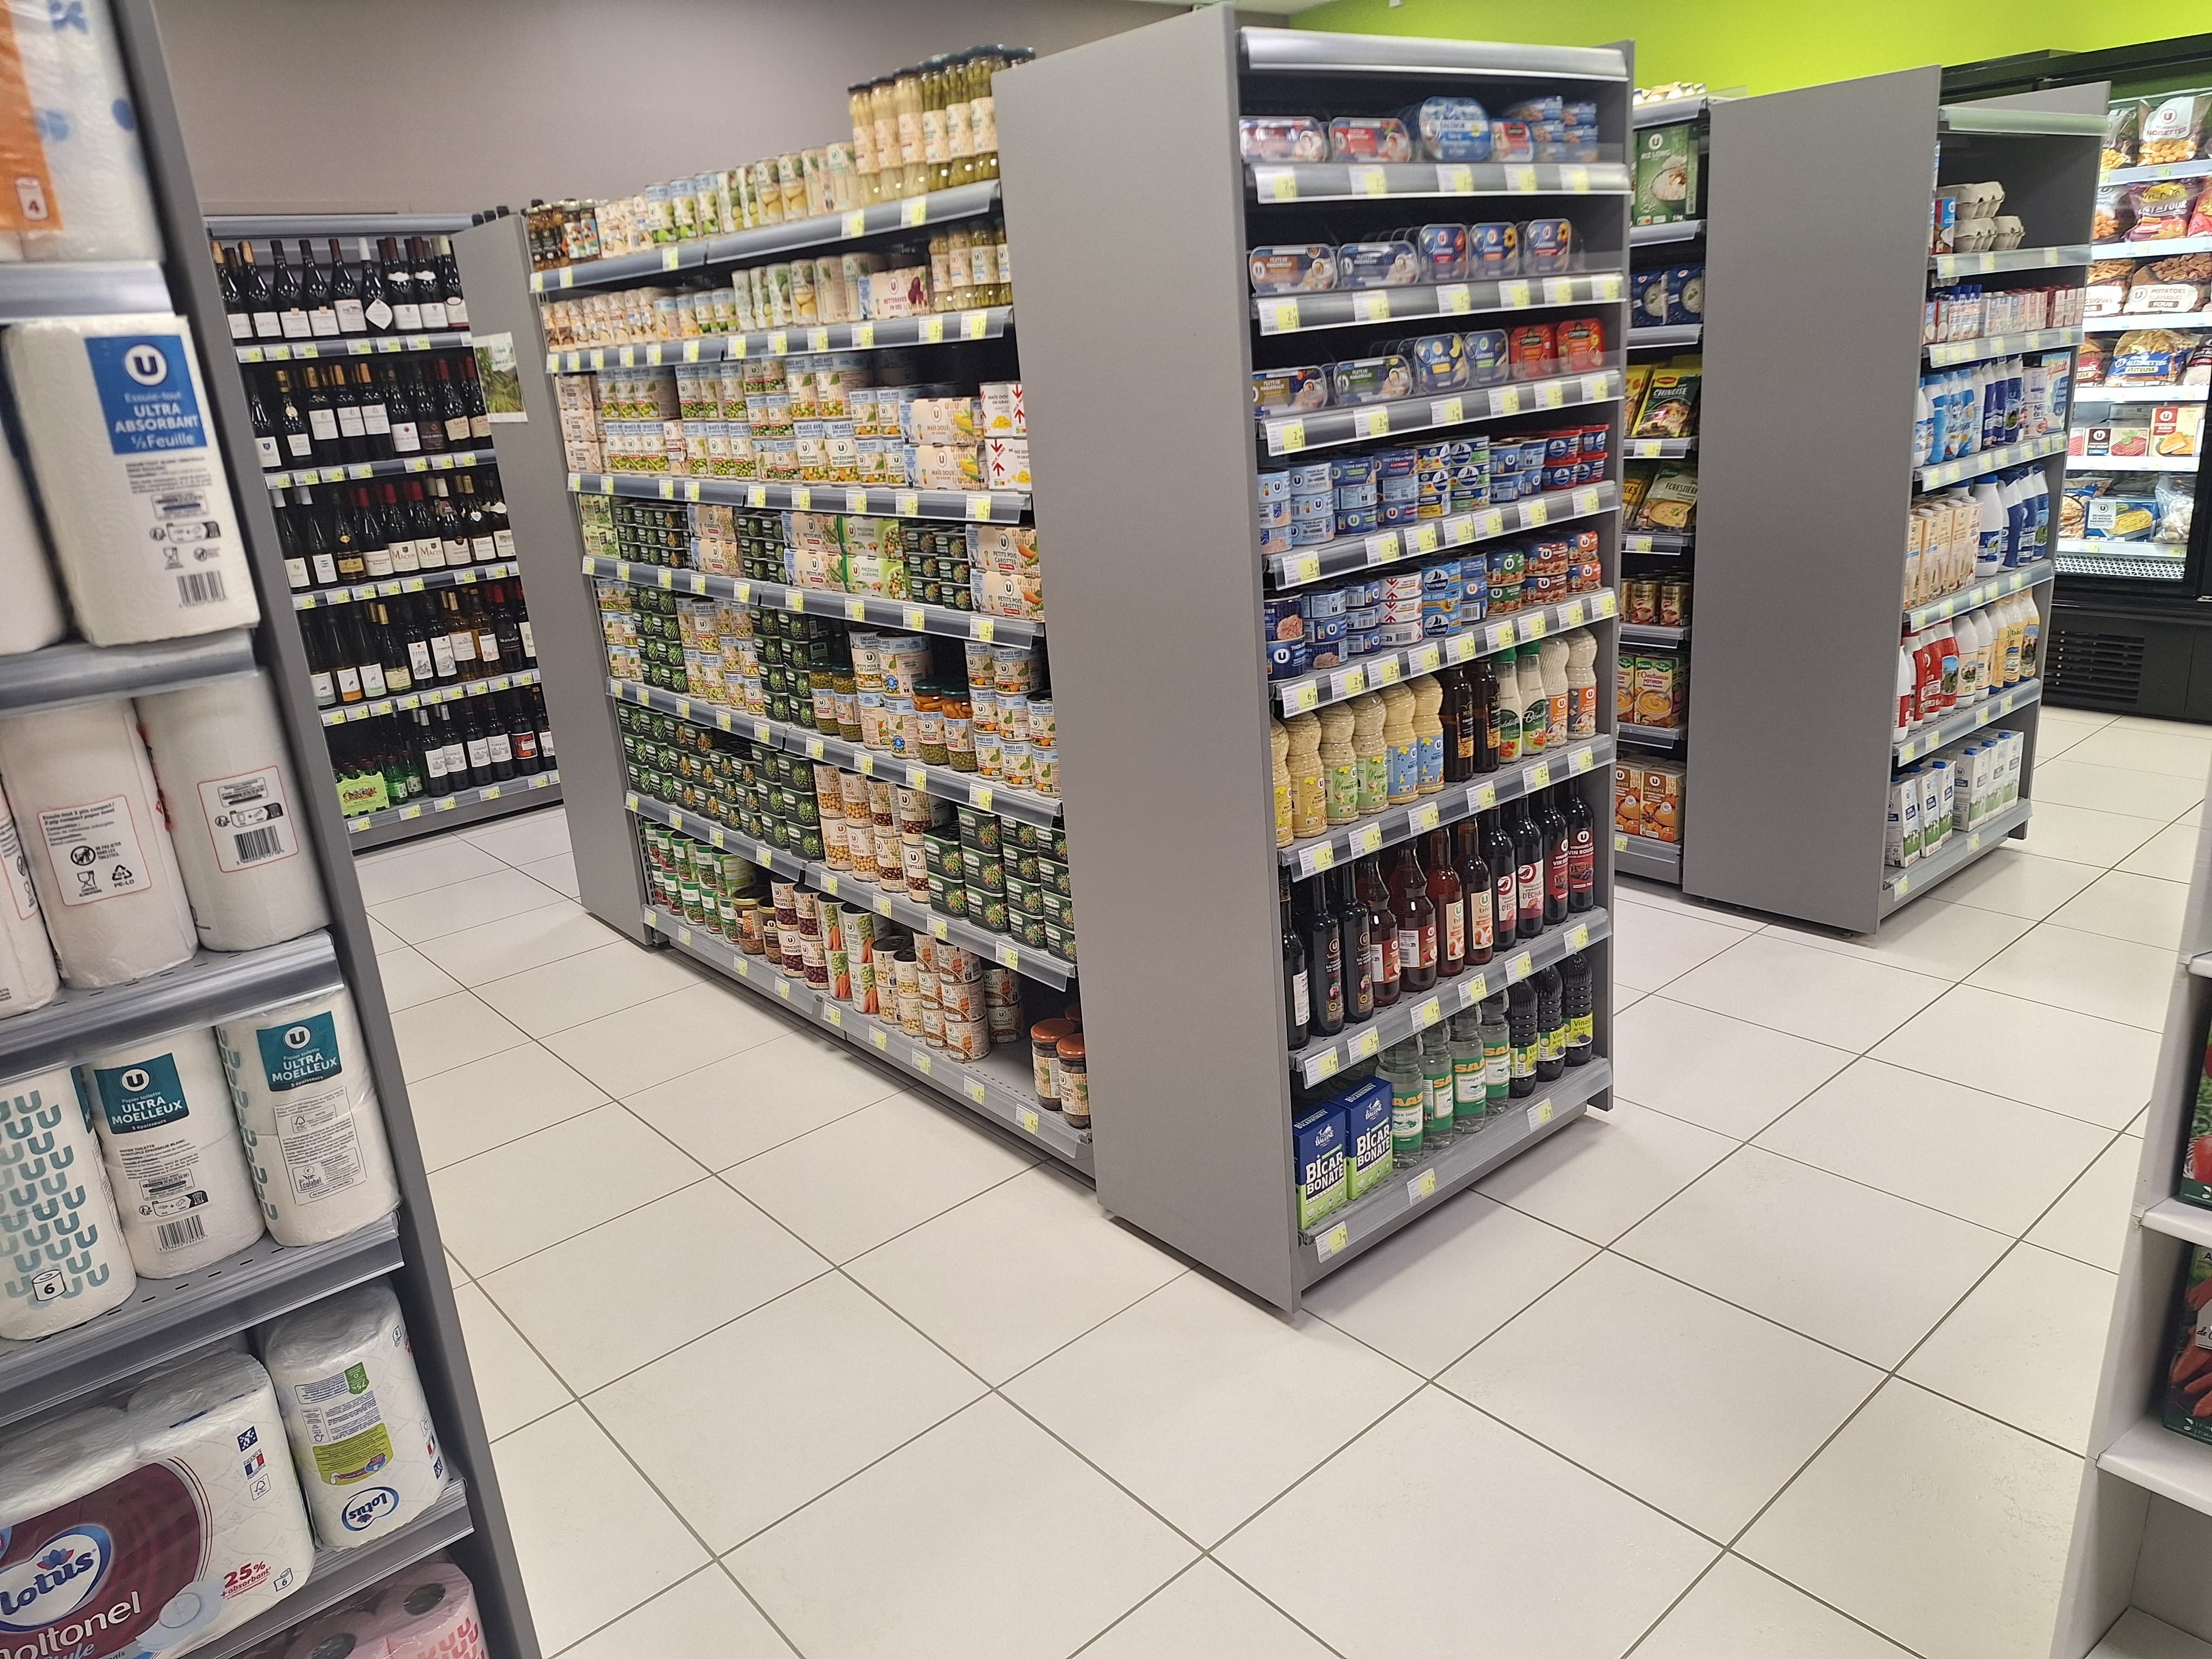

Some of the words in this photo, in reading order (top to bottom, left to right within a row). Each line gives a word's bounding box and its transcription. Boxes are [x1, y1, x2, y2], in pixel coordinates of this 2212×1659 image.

[2165, 112, 2172, 120] U
[2146, 126, 2187, 137] NOISETTES
[1653, 138, 1660, 149] U
[28, 198, 40, 214] 4
[890, 281, 898, 291] U
[2134, 290, 2143, 298] U
[133, 355, 158, 376] U
[133, 402, 181, 417] ULTRA
[114, 415, 198, 434] ABSORBANT
[146, 432, 195, 448] Feuille
[1275, 483, 1280, 491] U
[1315, 500, 1321, 509] U
[1278, 651, 1287, 661] U
[902, 795, 908, 803] U
[114, 879, 134, 888] PE-LD
[1481, 895, 1488, 903] U
[290, 1031, 305, 1045] U
[283, 1053, 324, 1070] ULTRA
[272, 1057, 338, 1082] MOELLEUX
[126, 1073, 144, 1087] U
[140, 1091, 161, 1100] toilette
[1344, 1083, 1377, 1102] BICARBONATE
[122, 1096, 166, 1113] ULTRA
[112, 1100, 183, 1125] MOELLEUX
[1294, 1110, 1328, 1129] BICARBONATE
[1356, 1124, 1390, 1156] BICAR
[1358, 1136, 1390, 1167] BONATE
[1306, 1151, 1343, 1185] BICAR
[299, 1177, 322, 1189] Ecolabel
[1307, 1163, 1343, 1195] BONATE
[44, 1282, 55, 1295] 6
[348, 1492, 388, 1520] Lotus
[224, 1561, 267, 1588] 25%
[1, 1551, 94, 1615] Lotus
[281, 1578, 288, 1587] 6
